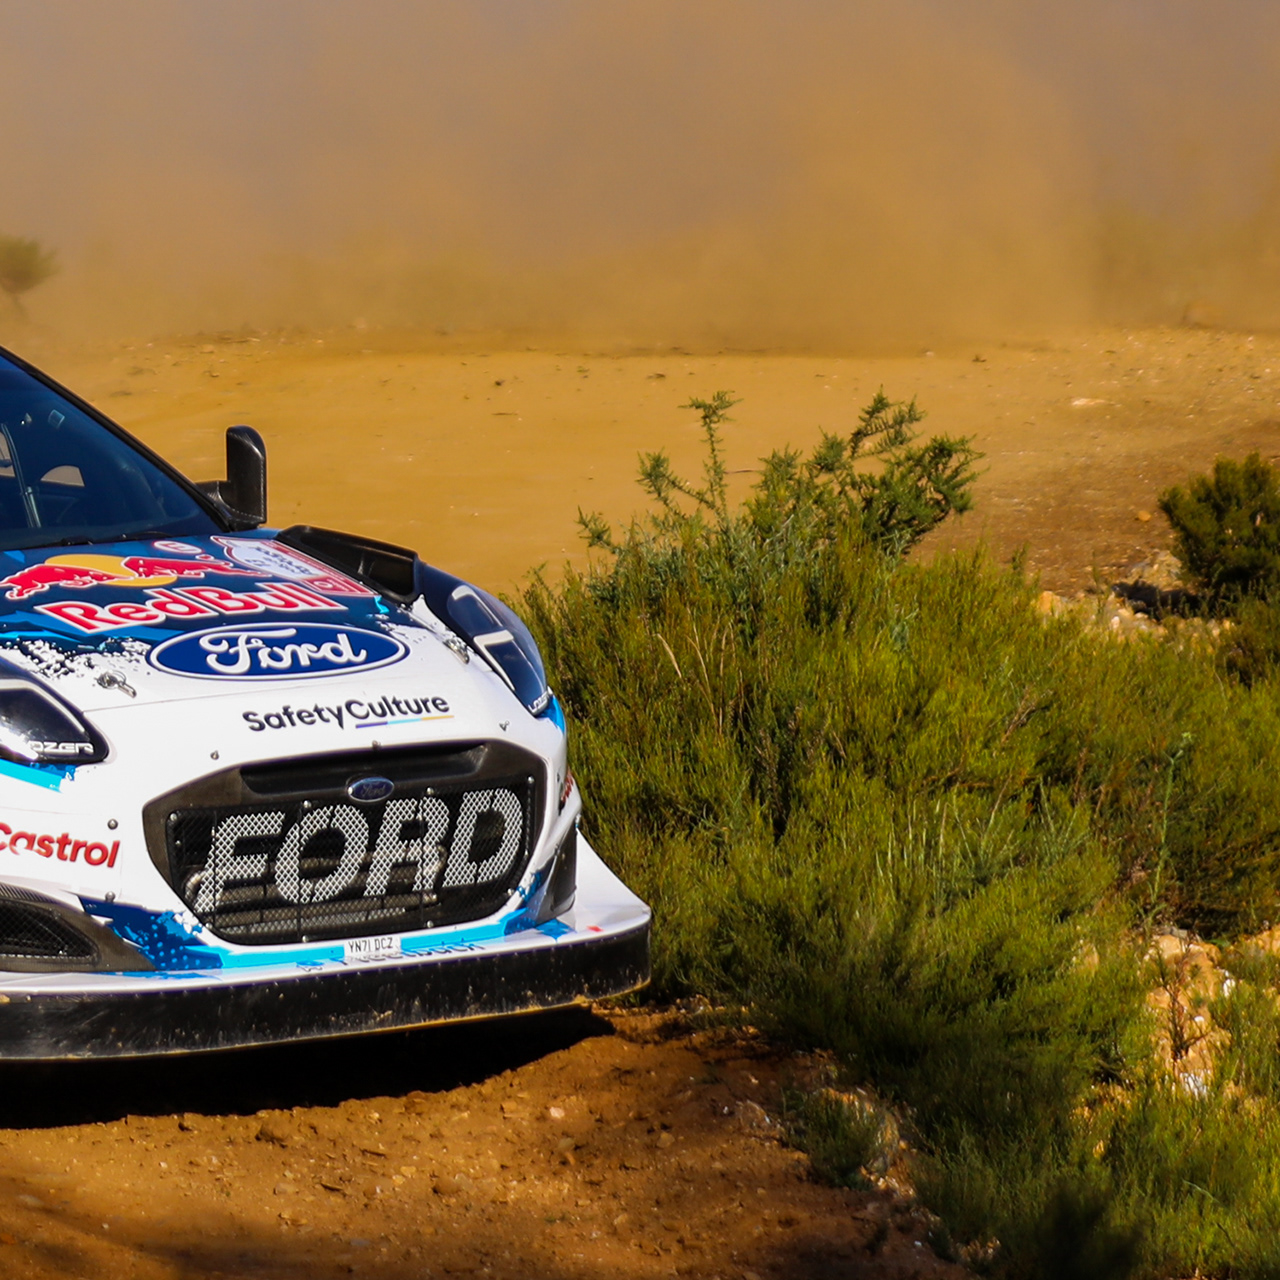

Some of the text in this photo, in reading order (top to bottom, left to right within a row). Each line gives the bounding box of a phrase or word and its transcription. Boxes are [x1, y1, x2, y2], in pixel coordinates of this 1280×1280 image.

[199, 627, 368, 675] Ford
[242, 695, 450, 732] SafetyCulture
[193, 787, 527, 914] FORD
[348, 937, 394, 954] YN71 DCZ
